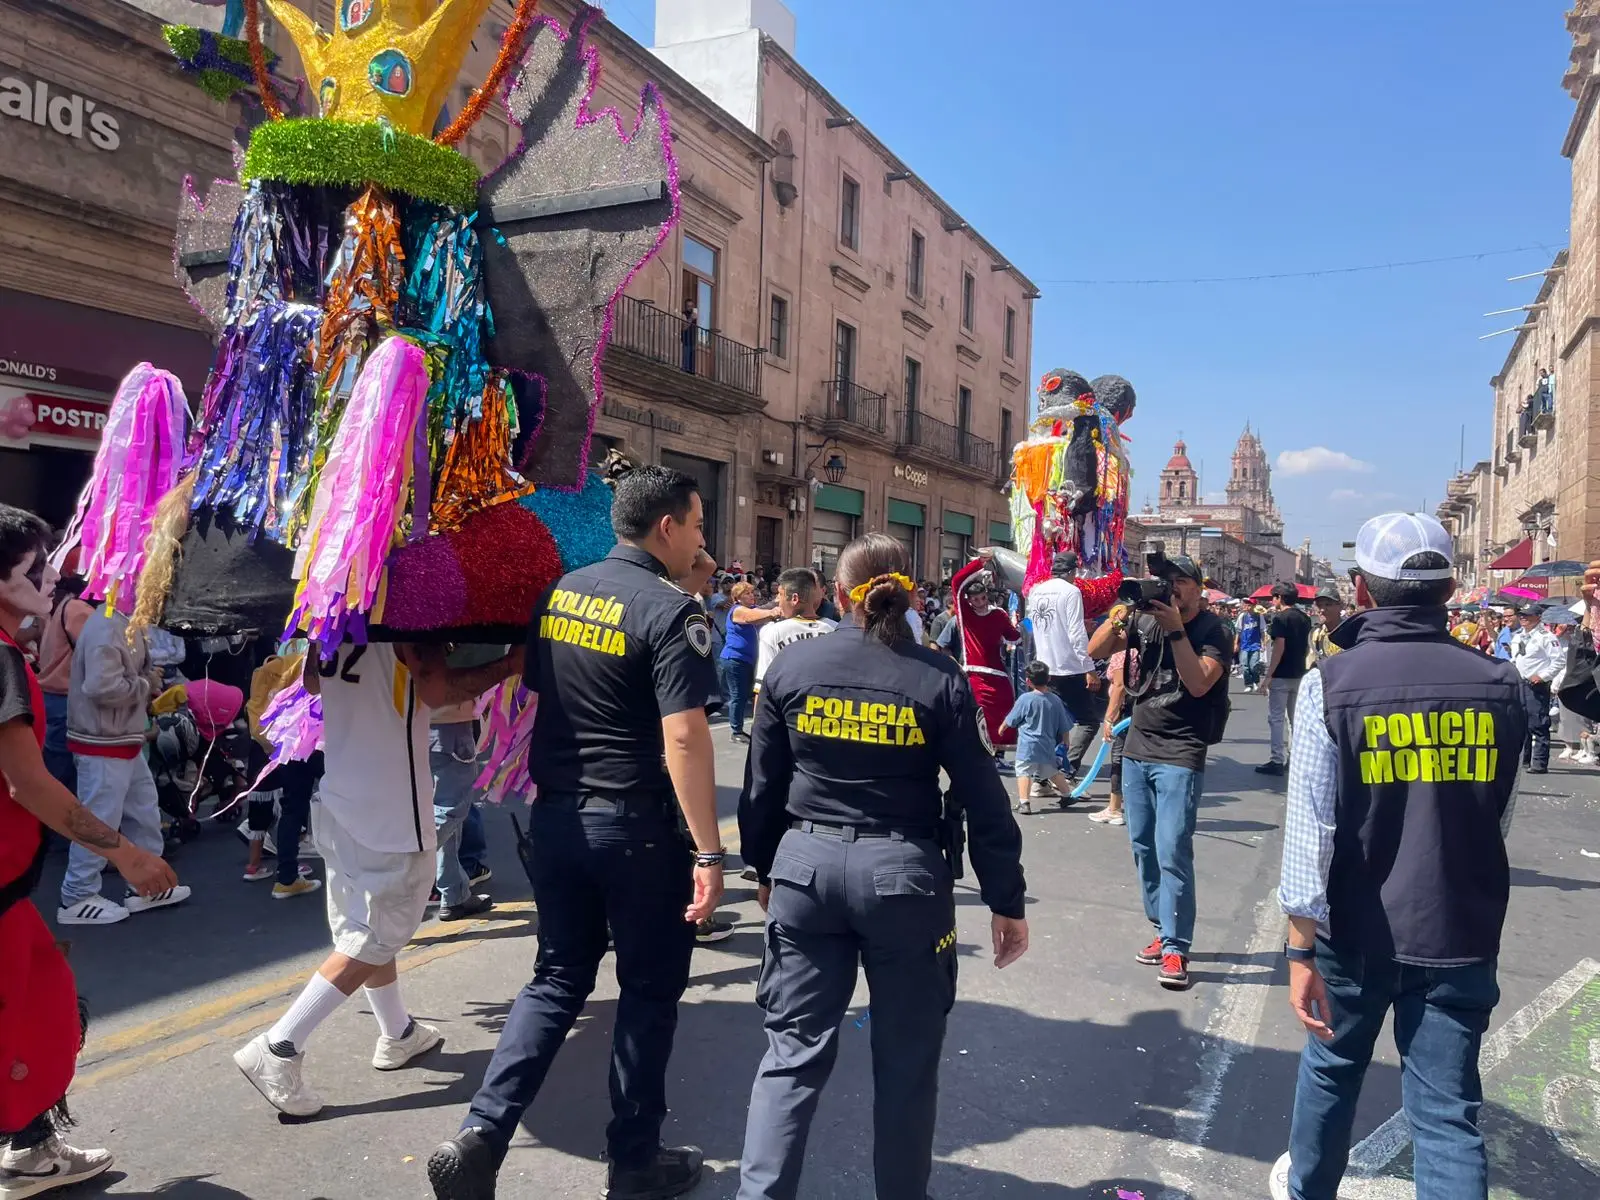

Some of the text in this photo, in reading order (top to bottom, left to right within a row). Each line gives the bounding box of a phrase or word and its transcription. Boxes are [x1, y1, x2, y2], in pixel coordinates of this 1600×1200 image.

[905, 464, 928, 488] Coppel
[547, 589, 625, 626] POLICÍA
[540, 615, 626, 657] MORELIA
[797, 713, 926, 746] MORELIA
[1363, 708, 1495, 748] POLICÍA
